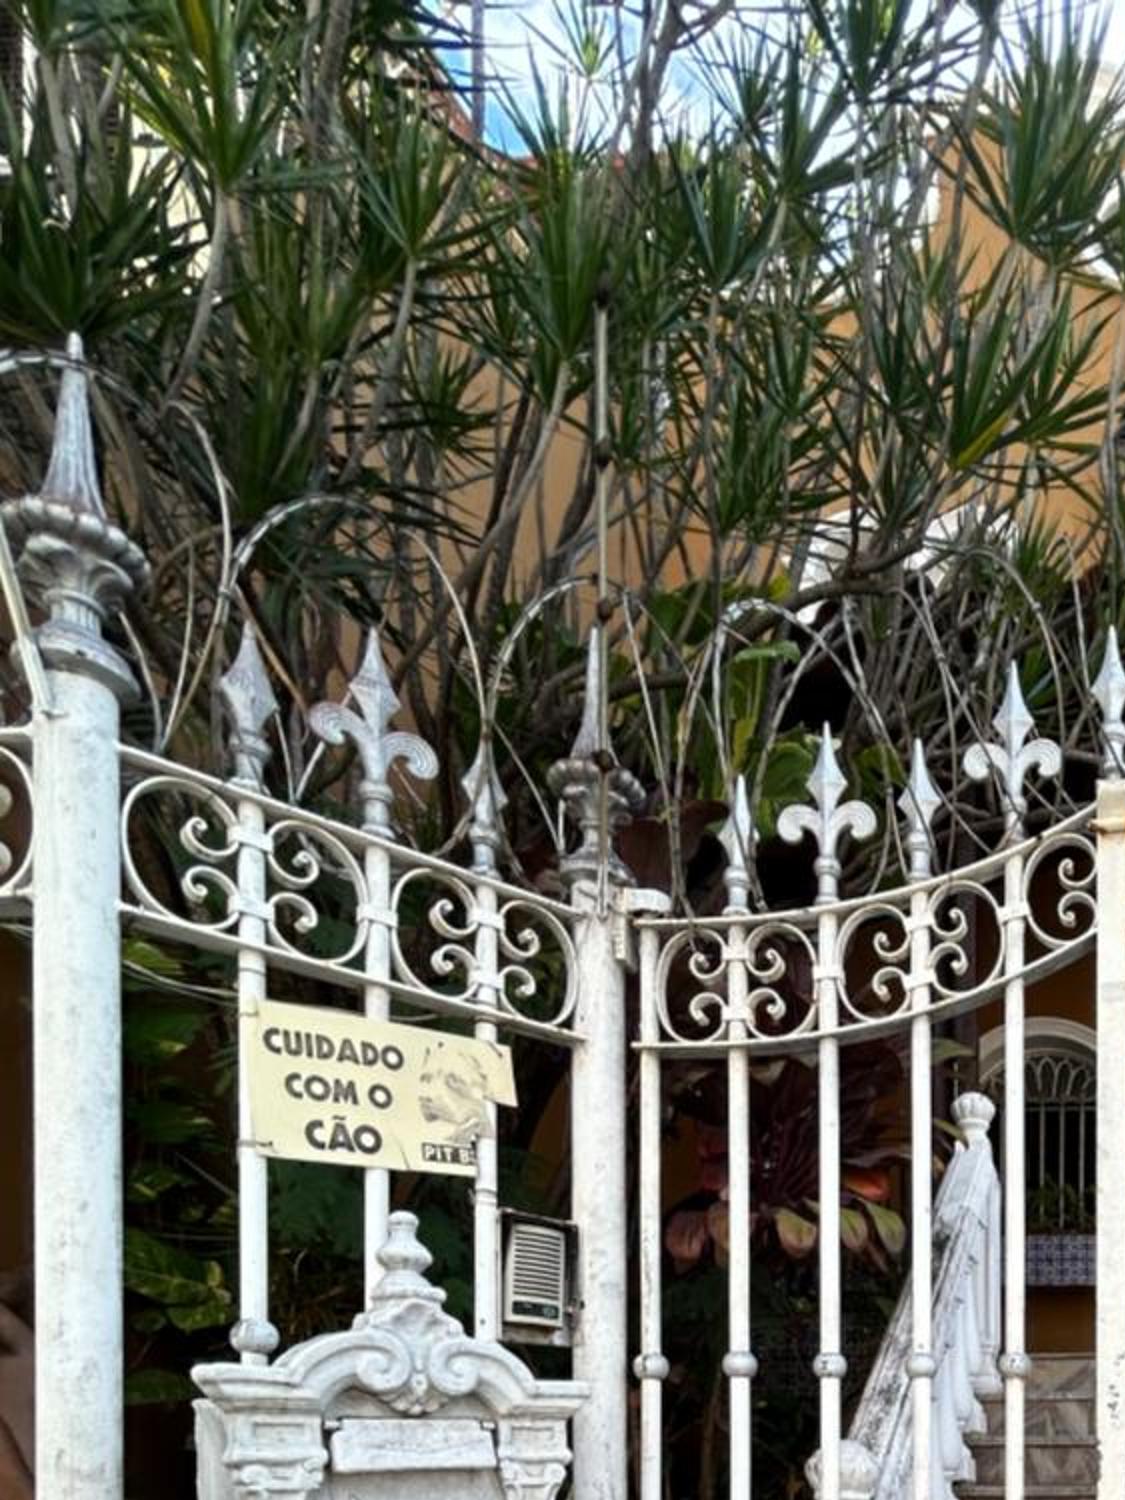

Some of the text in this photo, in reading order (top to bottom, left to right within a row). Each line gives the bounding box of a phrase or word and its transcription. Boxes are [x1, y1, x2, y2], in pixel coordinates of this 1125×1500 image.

[262, 1027, 405, 1071] CUIDADO
[284, 1072, 393, 1110] COM O
[304, 1115, 383, 1155] CÃO
[424, 1144, 453, 1162] PIT
